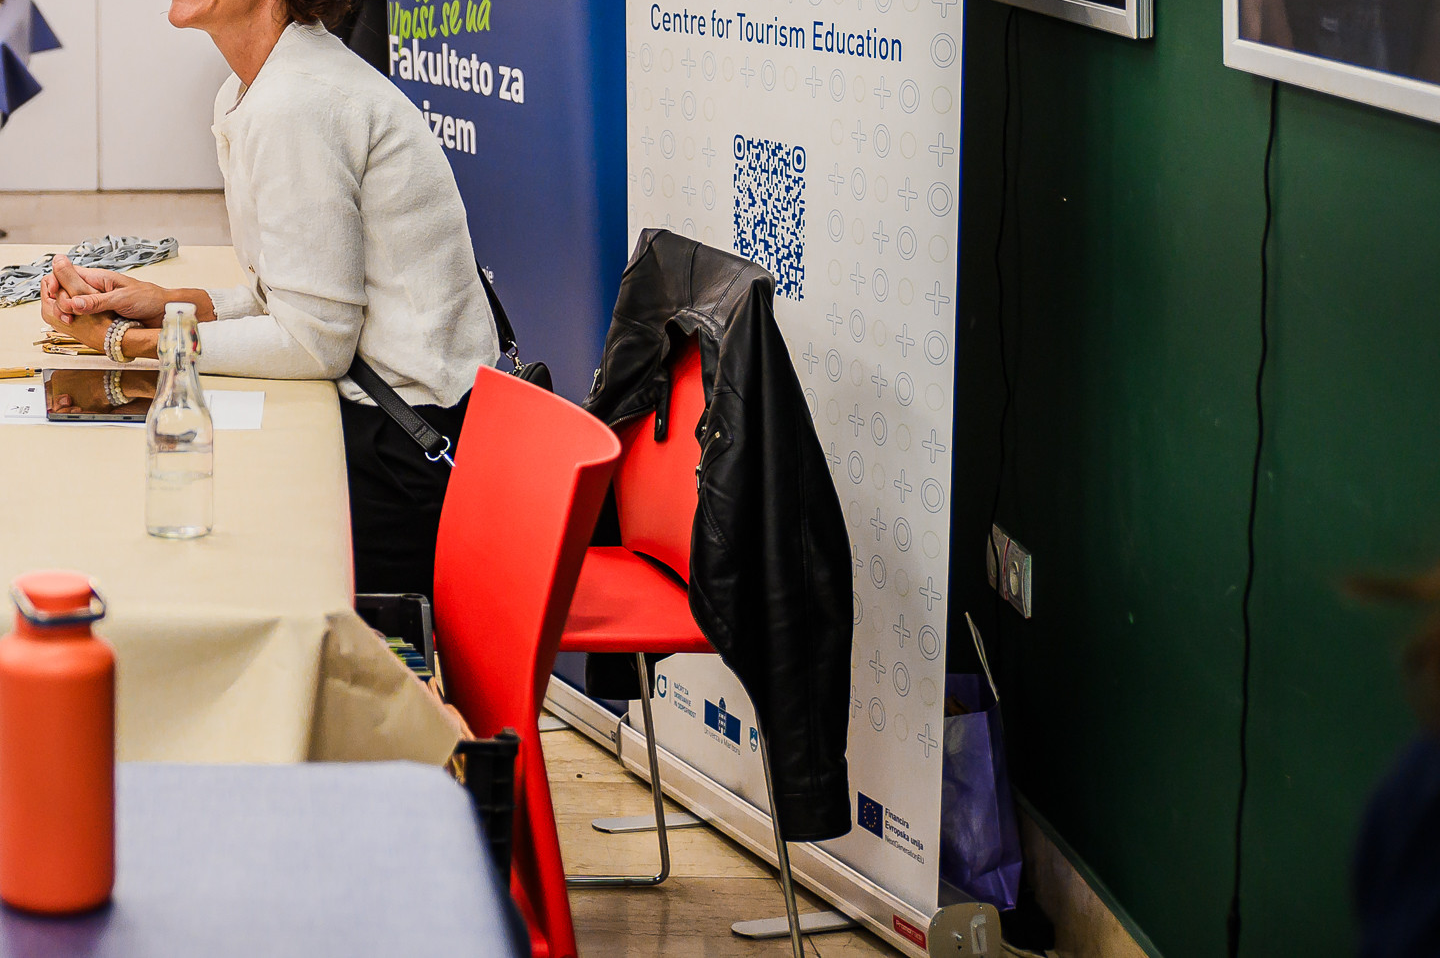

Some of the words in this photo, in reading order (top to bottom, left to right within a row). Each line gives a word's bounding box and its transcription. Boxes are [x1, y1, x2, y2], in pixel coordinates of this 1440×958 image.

[440, 0, 462, 38] se
[650, 3, 706, 36] Centre
[711, 9, 733, 39] for
[737, 12, 805, 50] Tourism
[813, 20, 902, 62] Education
[389, 34, 494, 96] Fakulteto
[498, 65, 525, 104] za
[422, 100, 477, 155] izem
